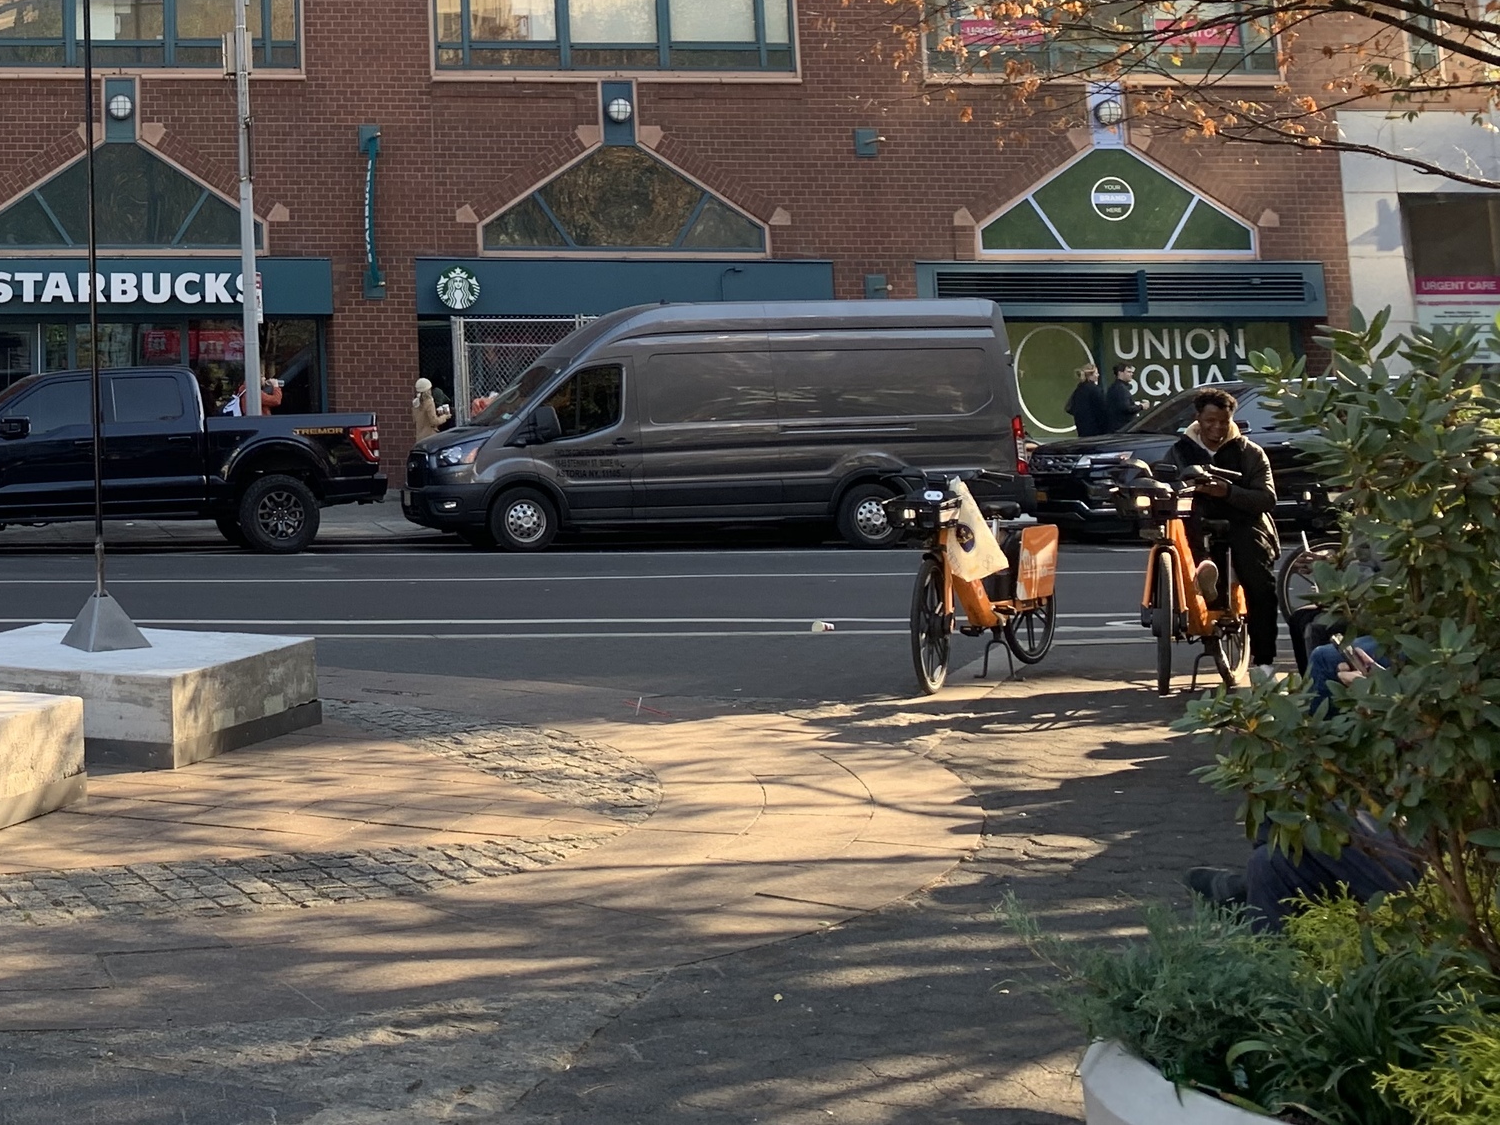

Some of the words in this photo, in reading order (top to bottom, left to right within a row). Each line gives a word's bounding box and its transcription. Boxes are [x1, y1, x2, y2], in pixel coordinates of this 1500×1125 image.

[1422, 281, 1465, 290] URGENT
[1467, 280, 1497, 290] CARE
[1112, 328, 1247, 360] UNION
[294, 427, 344, 435] TREMOR
[556, 469, 587, 477] ASTORIA
